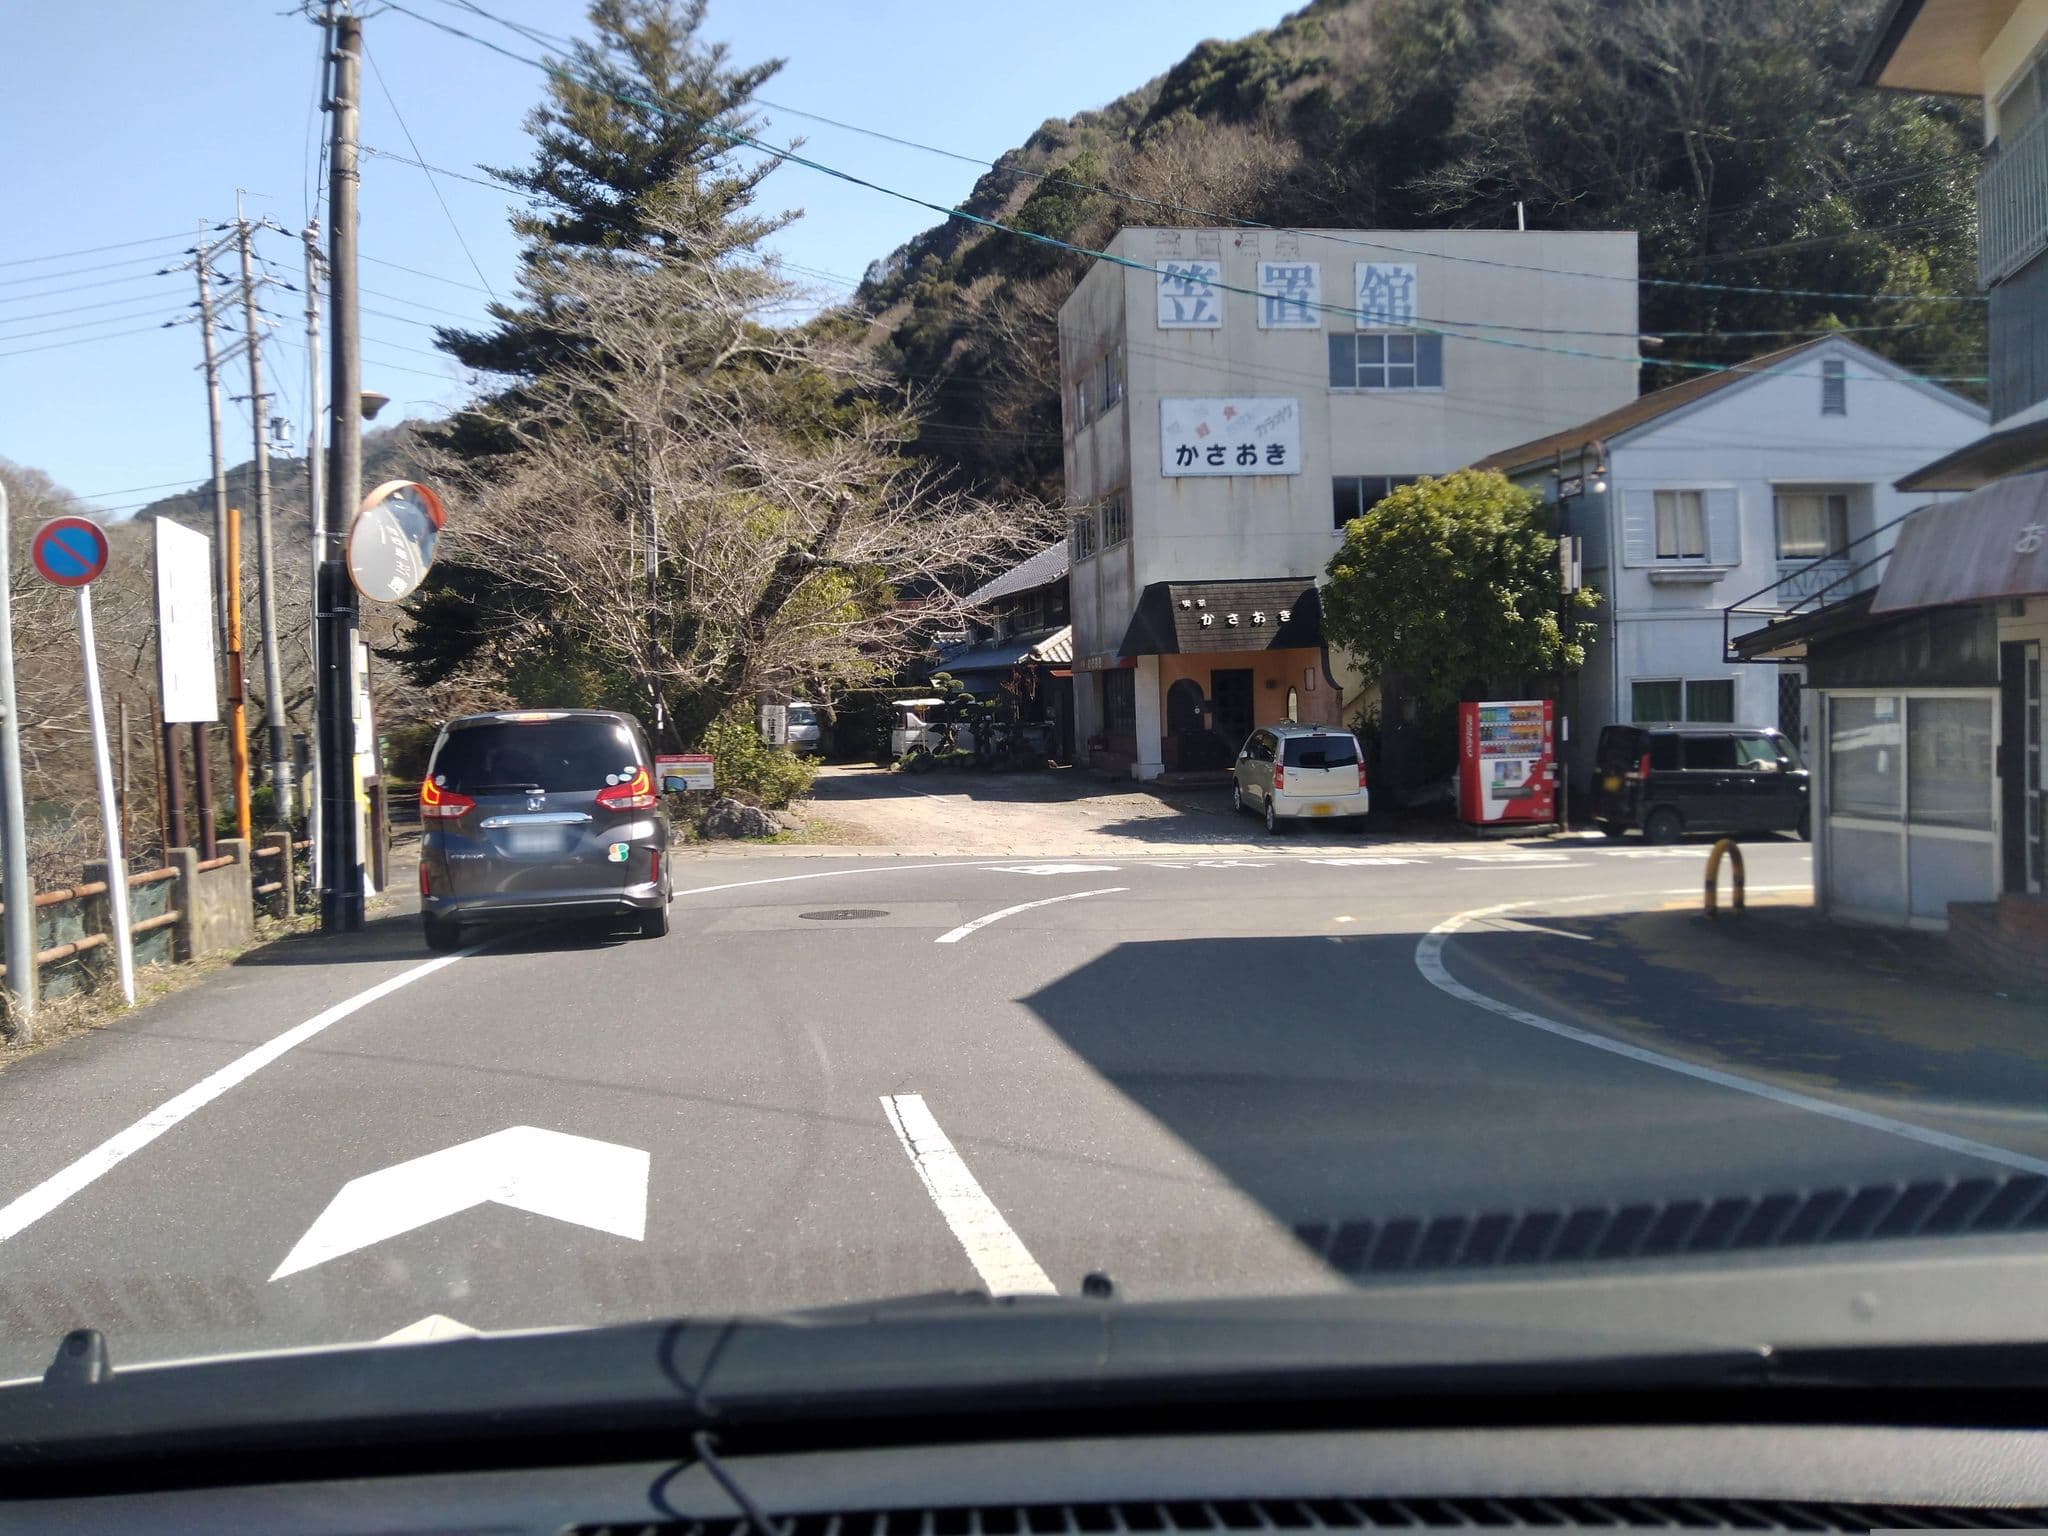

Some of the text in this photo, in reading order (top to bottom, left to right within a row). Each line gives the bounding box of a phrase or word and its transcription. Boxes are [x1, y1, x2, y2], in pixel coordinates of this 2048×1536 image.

[1175, 442, 1287, 467] かさおき
[1200, 609, 1292, 626] かさおき
